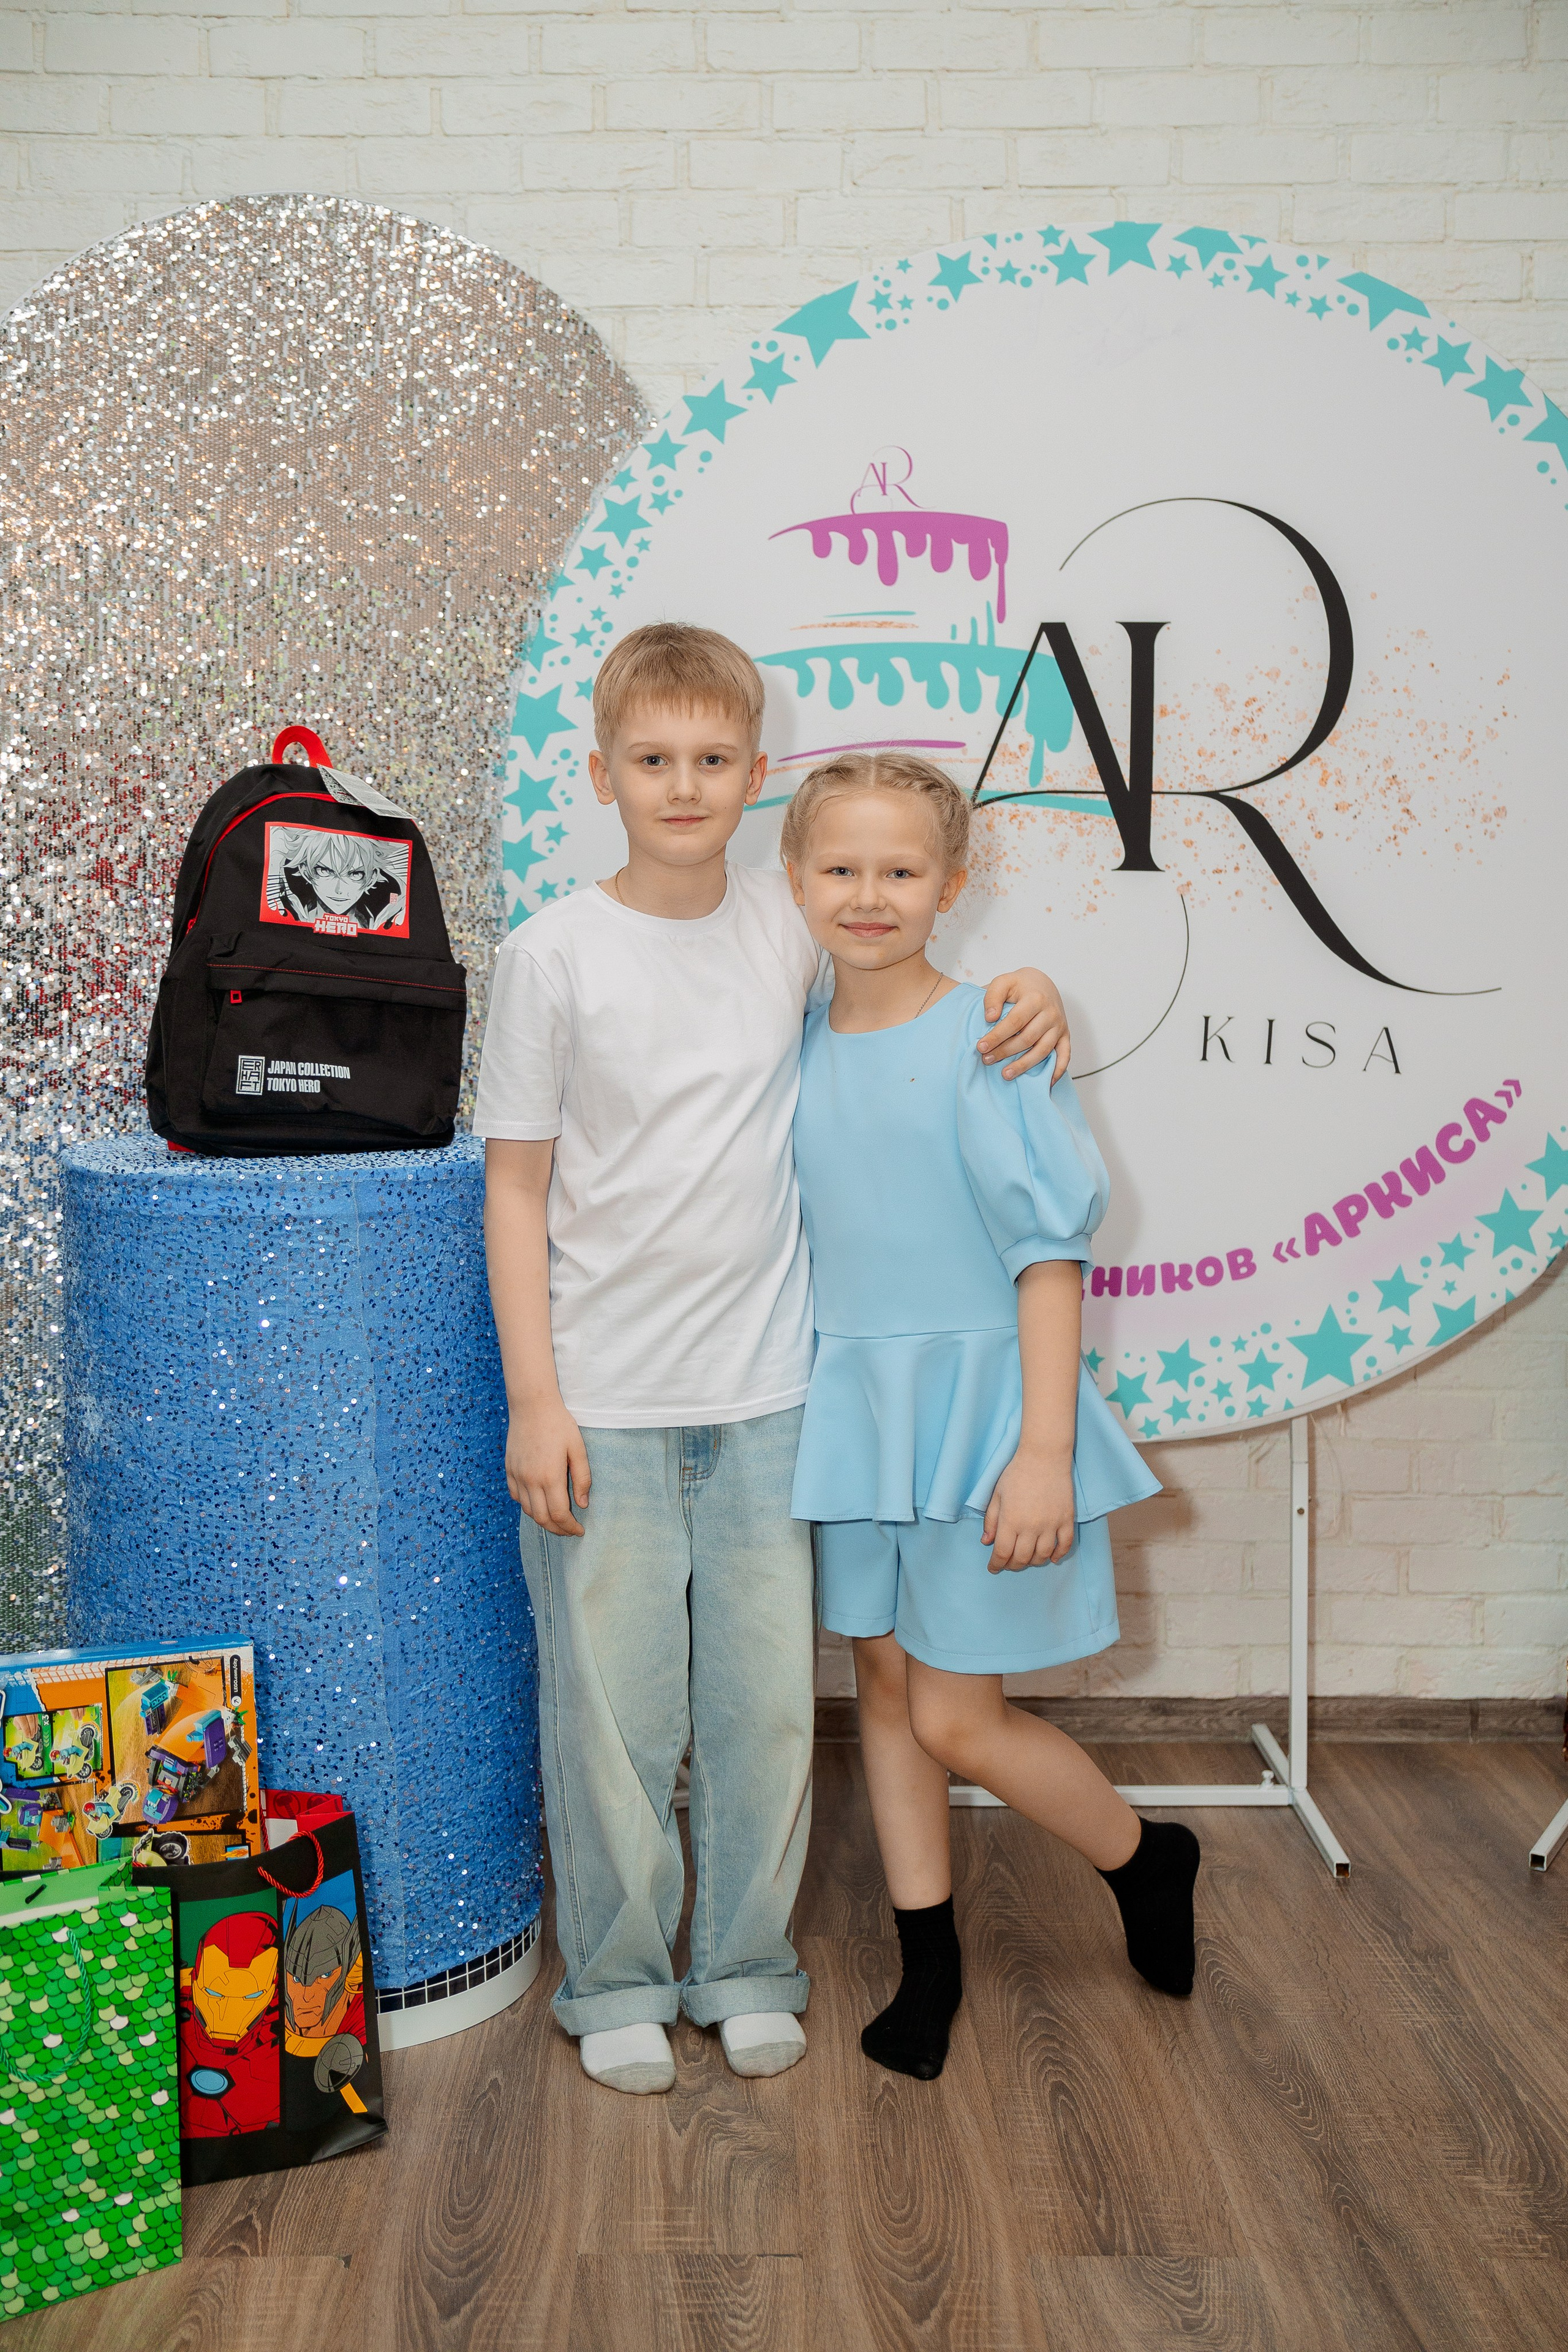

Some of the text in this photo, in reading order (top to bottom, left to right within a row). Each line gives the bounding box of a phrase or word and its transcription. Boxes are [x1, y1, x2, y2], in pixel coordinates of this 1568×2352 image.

[324, 914, 349, 923] TOKYO
[314, 919, 357, 936] HERO
[1199, 1015, 1401, 1074] KISA
[267, 1060, 351, 1079] JAPAN COLLECTION
[267, 1077, 321, 1093] TOKYO HERO
[1082, 1079, 1522, 1302] НИКОВ «АРКИСА»
[42, 1714, 50, 1726] x3
